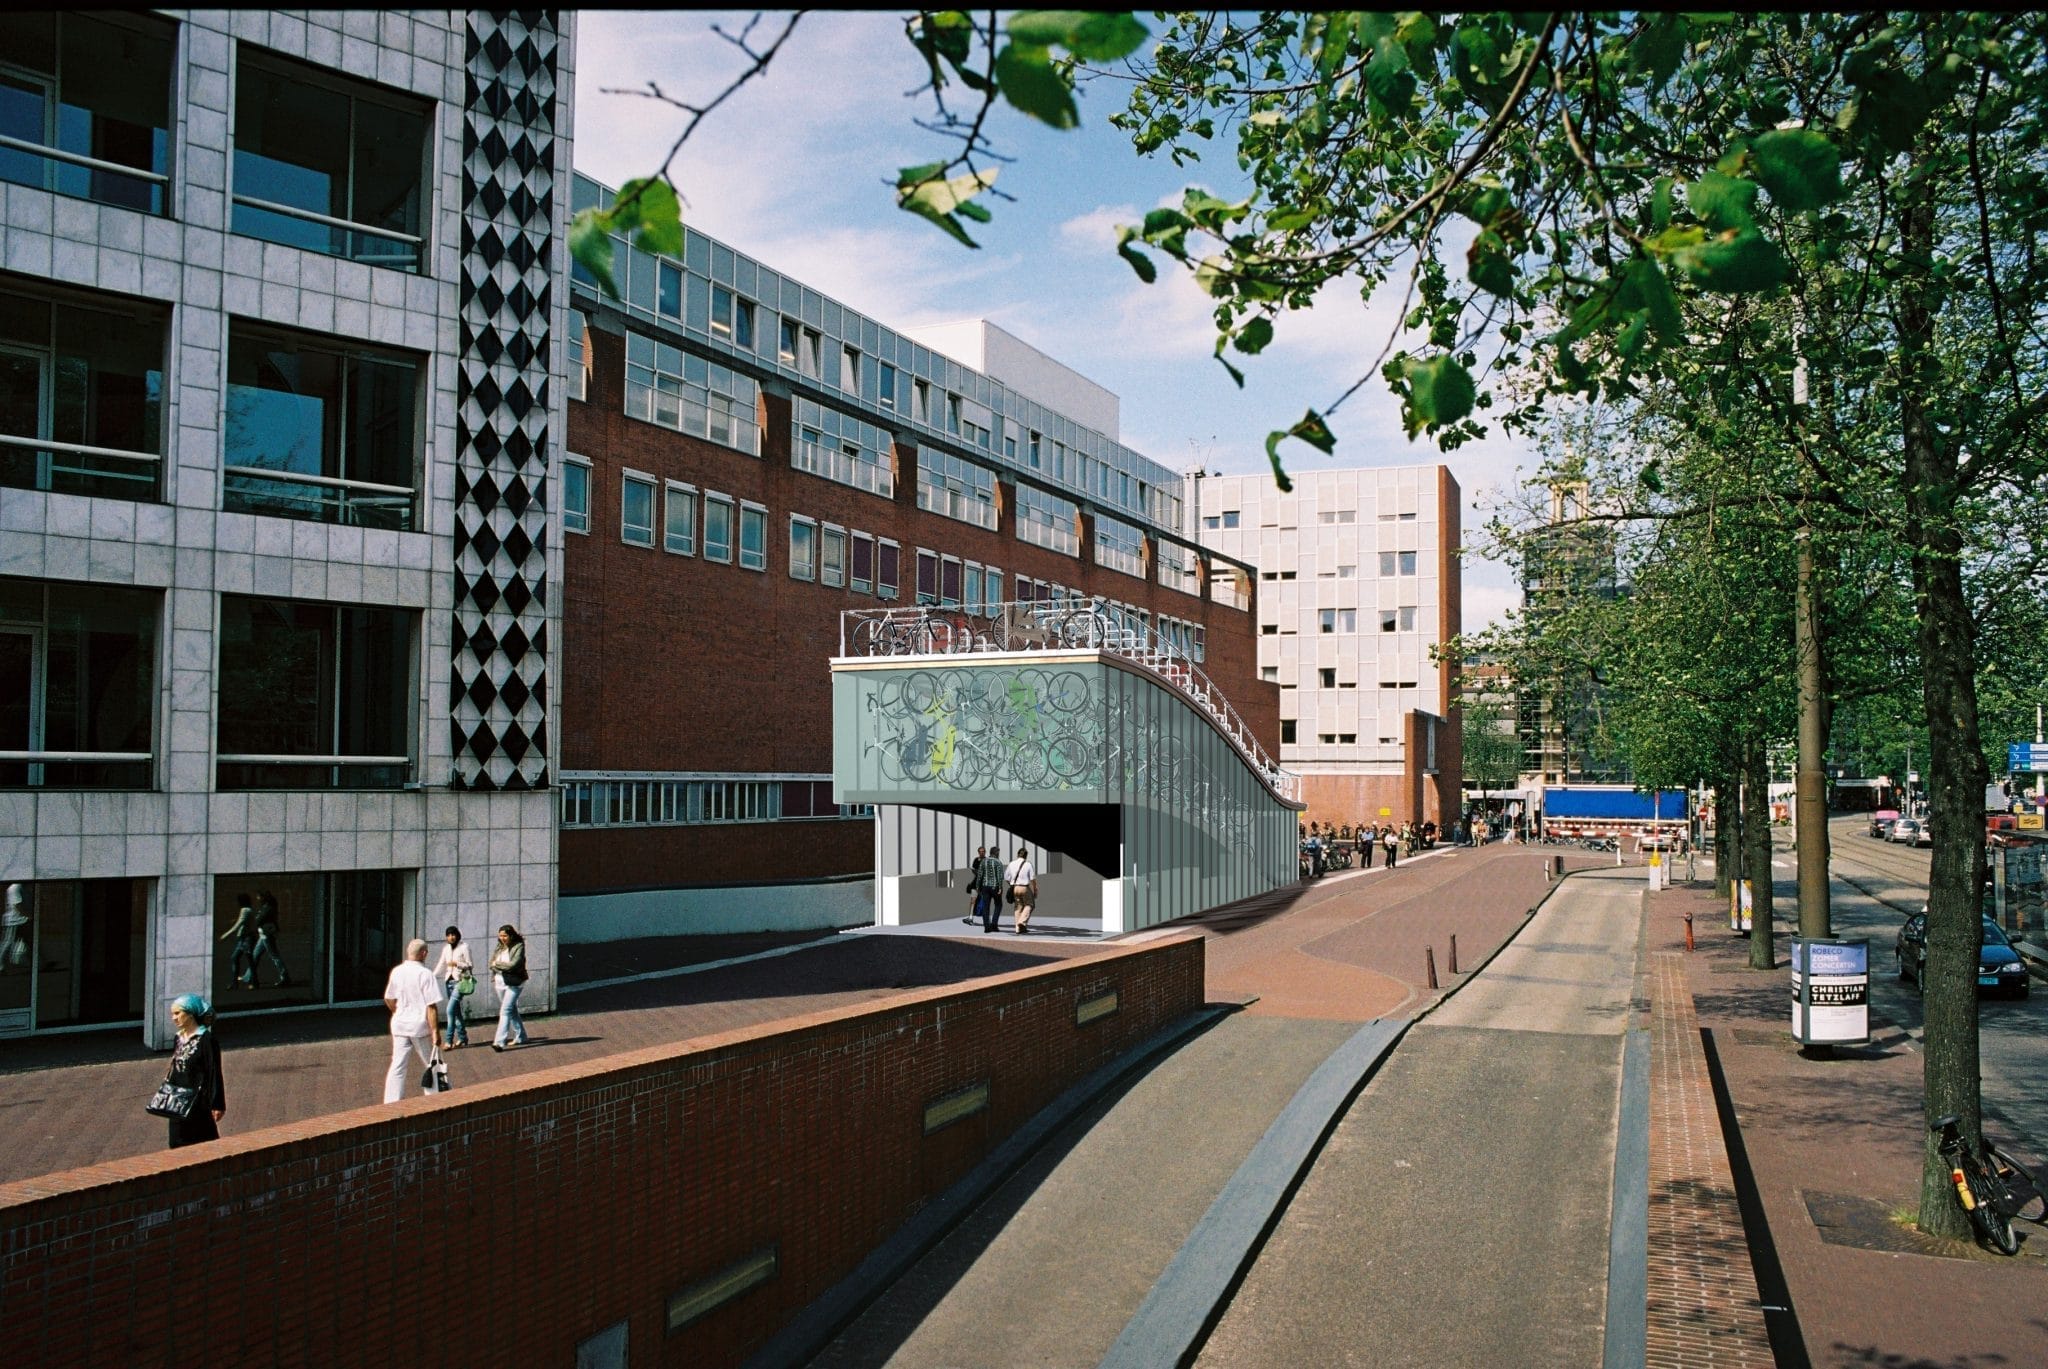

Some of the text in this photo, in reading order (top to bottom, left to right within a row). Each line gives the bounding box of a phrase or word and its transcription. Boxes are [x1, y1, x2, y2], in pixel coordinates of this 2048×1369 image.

[1811, 947, 1843, 955] ROBECO
[1811, 985, 1865, 993] CHRISTIAN
[1811, 993, 1860, 1001] TETZLAFF
